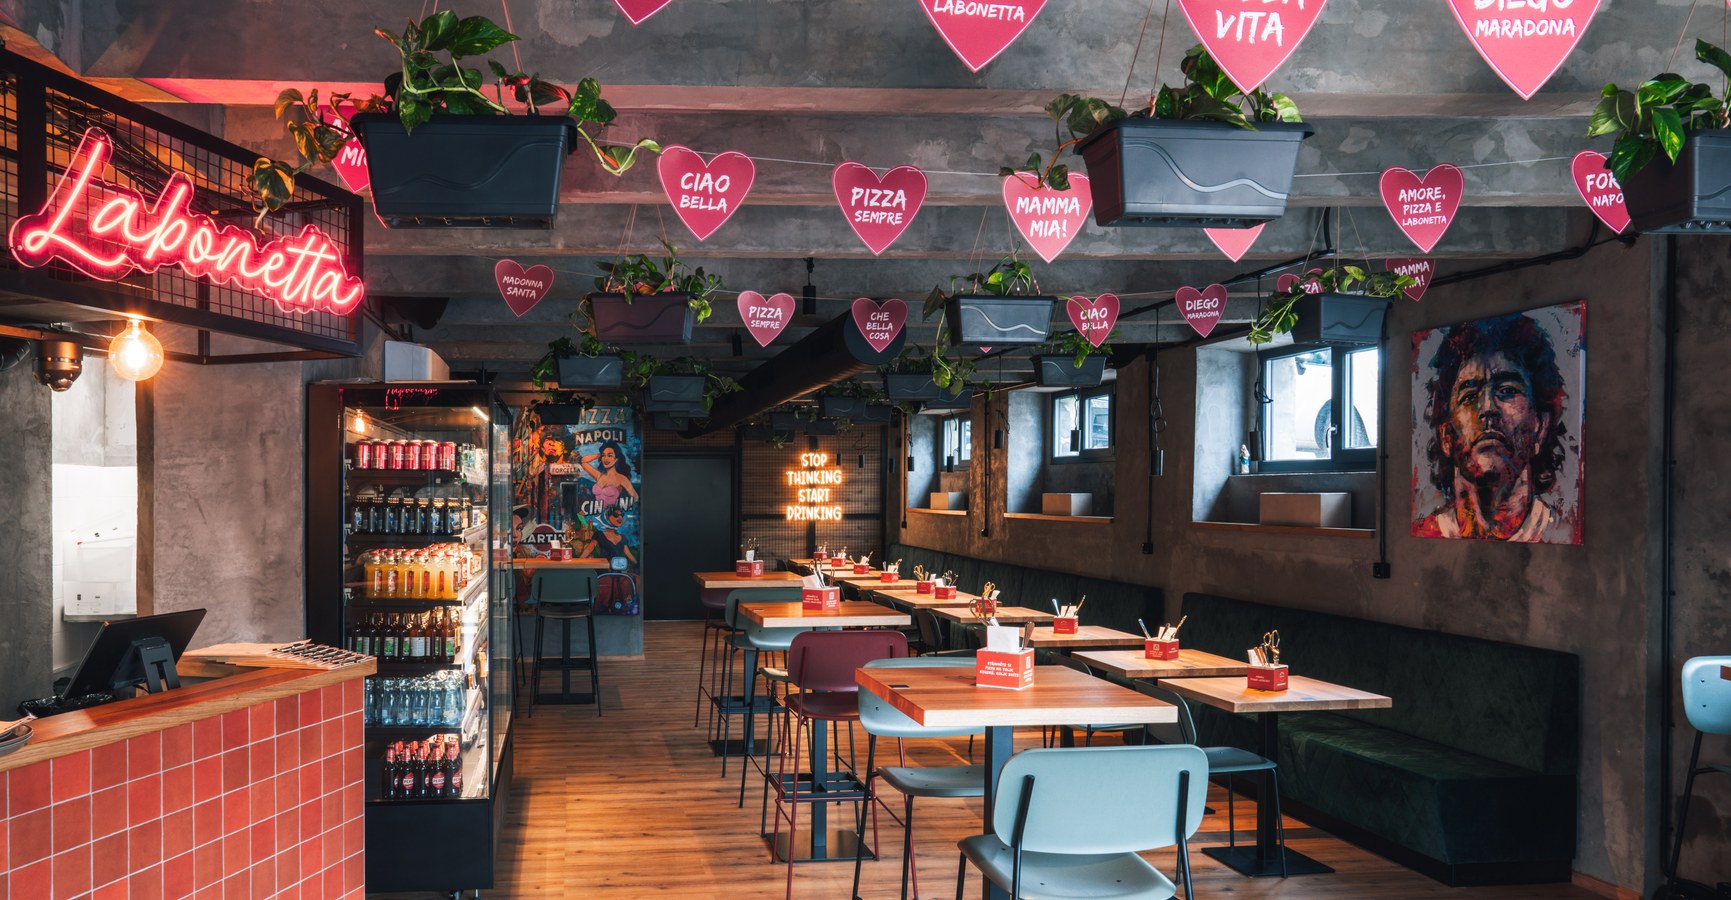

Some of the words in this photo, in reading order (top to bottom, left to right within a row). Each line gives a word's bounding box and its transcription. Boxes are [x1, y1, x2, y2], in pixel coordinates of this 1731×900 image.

[933, 0, 1025, 22] LABONETTA
[1215, 9, 1285, 47] VITA
[1475, 18, 1576, 39] MARADONA
[341, 146, 367, 167] MI
[681, 172, 730, 195] CIAO
[851, 186, 907, 211] PIZZA
[1398, 186, 1446, 203] AMORE,
[680, 194, 727, 213] BELLA
[1016, 196, 1080, 217] MAMMA
[1403, 202, 1432, 215] PIZZA
[1435, 202, 1442, 212] E
[23, 140, 360, 305] Labonetta
[854, 210, 903, 226] SEMPRE
[1402, 215, 1447, 227] LABONETTA
[1029, 219, 1067, 239] MIA!
[1394, 260, 1430, 277] MAMMA
[502, 275, 543, 290] MADONNA
[506, 287, 537, 300] SANTA
[1185, 297, 1219, 311] DIEGO
[749, 305, 783, 320] PIZZA
[870, 312, 890, 322] CHE
[1080, 307, 1108, 320] CIAO
[1187, 310, 1219, 320] MARADONA
[750, 319, 780, 329] SEMPRE
[866, 321, 894, 331] BELLA
[869, 332, 890, 340] COSA
[575, 429, 623, 446] NAPOLI
[801, 453, 828, 467] STOP
[786, 469, 842, 486] THINKING
[798, 488, 830, 502] START
[581, 499, 603, 515] CIN
[787, 505, 842, 520] DRINKING
